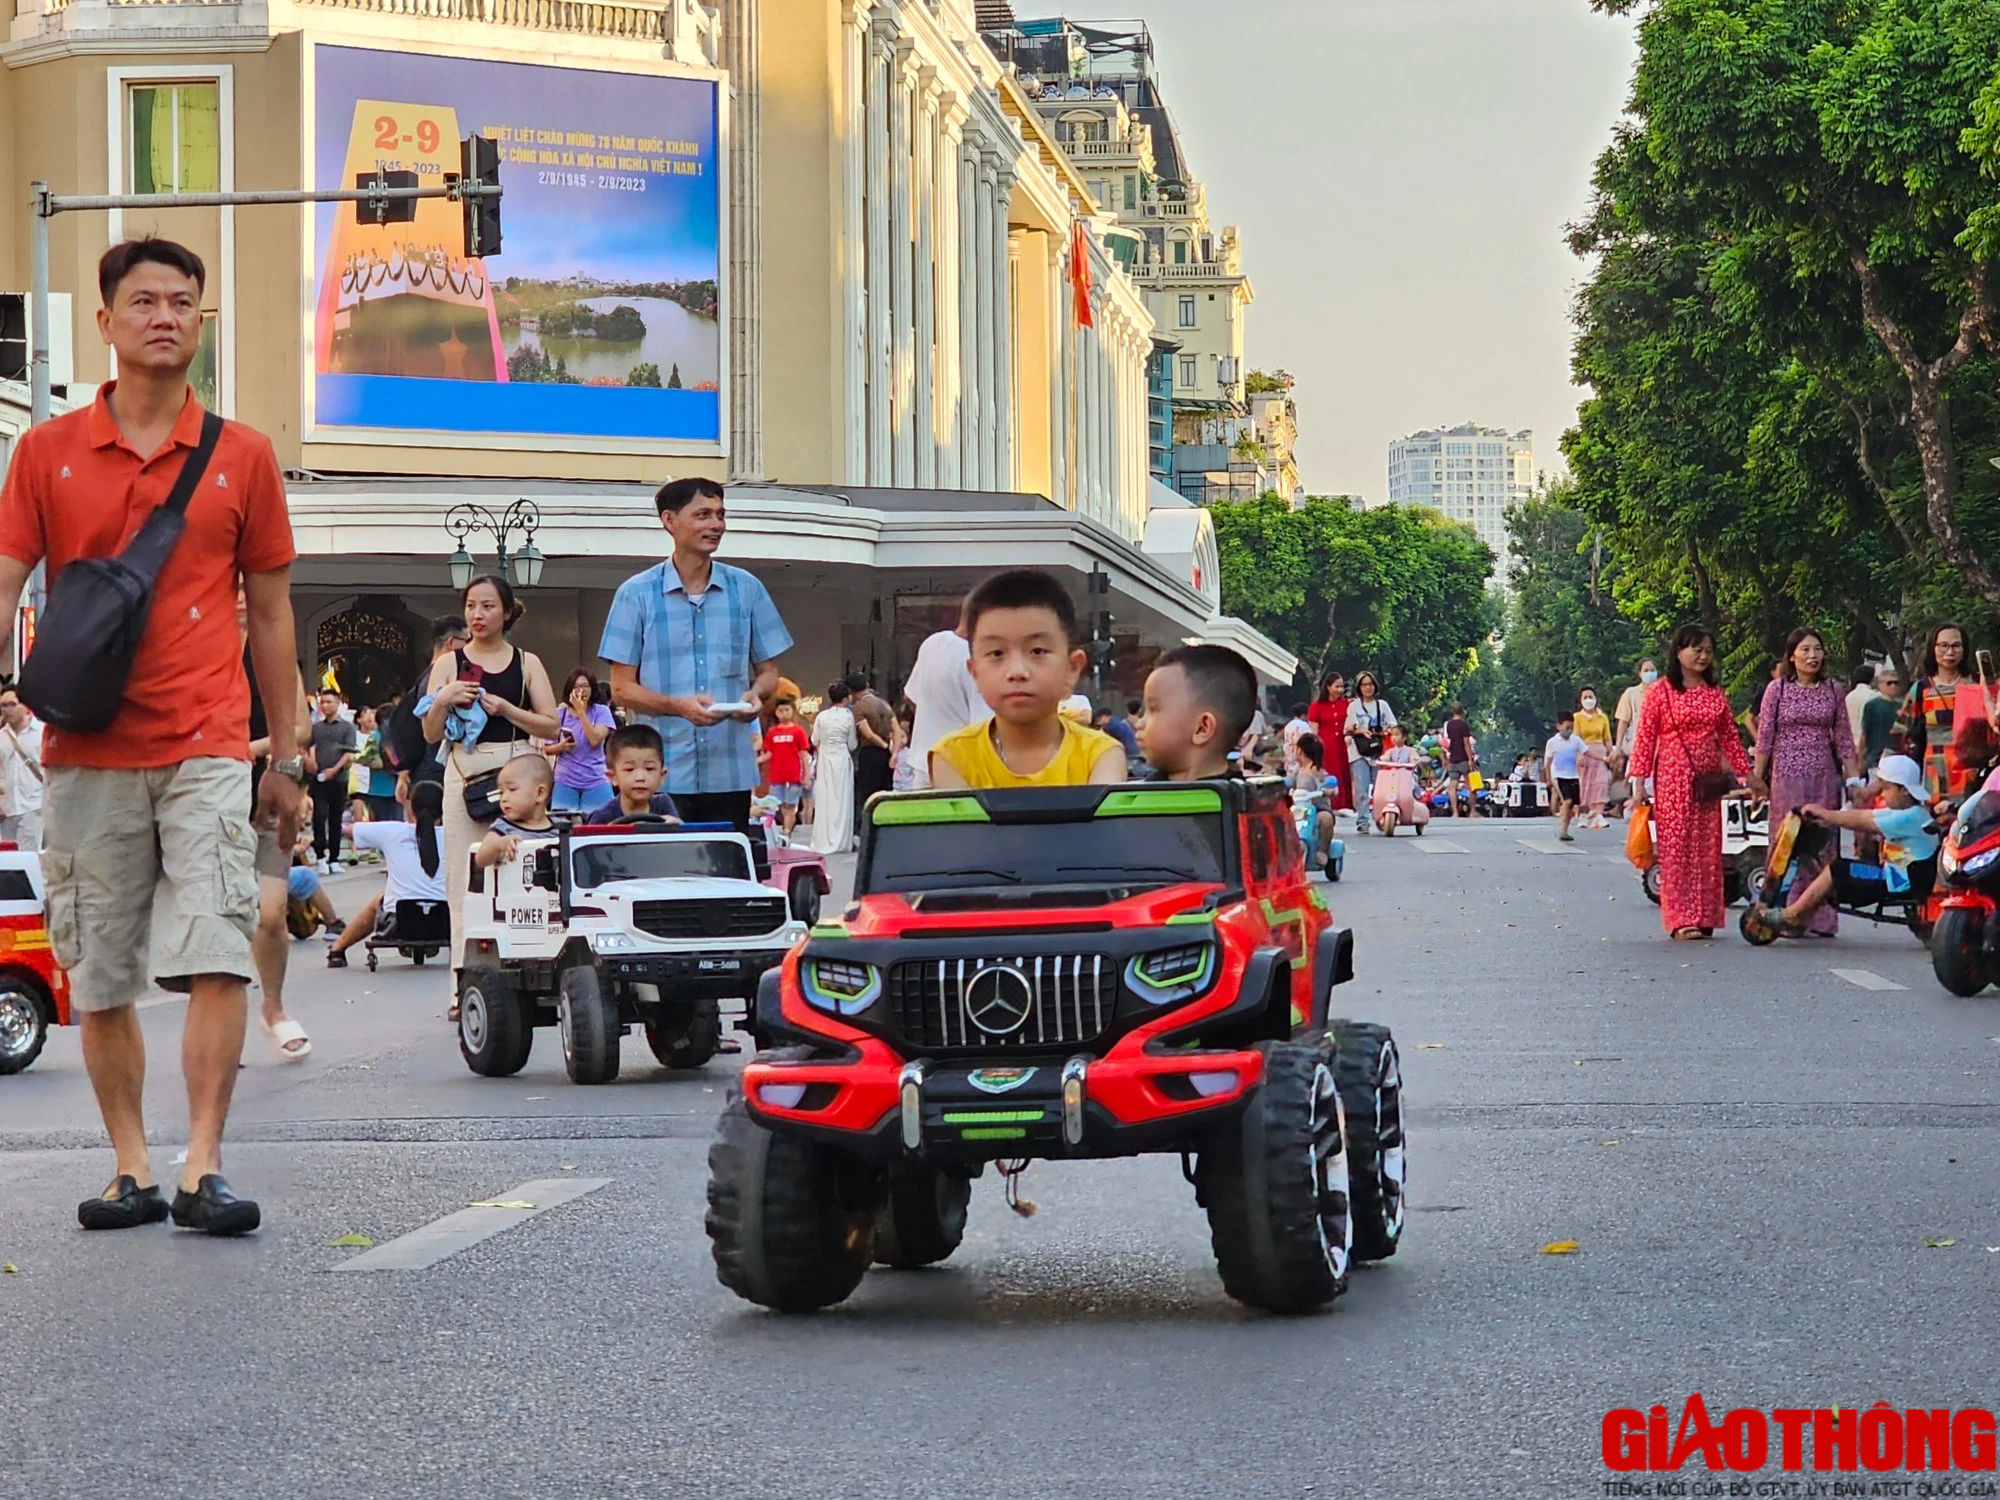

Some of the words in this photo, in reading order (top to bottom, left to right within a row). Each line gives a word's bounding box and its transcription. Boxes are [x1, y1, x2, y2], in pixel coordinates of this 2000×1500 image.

[374, 116, 440, 154] 2-9
[483, 125, 512, 143] NHIỆT
[514, 126, 535, 145] LIỆT
[537, 128, 564, 146] CHÀO
[566, 130, 596, 148] MỪNG
[612, 134, 635, 151] NĂM
[637, 136, 664, 154] QUỐC
[665, 139, 699, 157] KHÁNH
[413, 162, 441, 175] 2023
[509, 146, 537, 165] CỘNG
[539, 148, 559, 165] HÒA
[561, 150, 575, 167] XÃ
[577, 152, 594, 170] HỘI
[596, 152, 616, 169] CHỦ
[618, 156, 648, 172] NGHĨA
[650, 158, 671, 176] VIỆT
[673, 161, 696, 176] NAM
[698, 163, 702, 176] !
[538, 171, 587, 187] 2/9/1945
[598, 175, 646, 192] 2/9/2023
[511, 908, 543, 924] POWER
